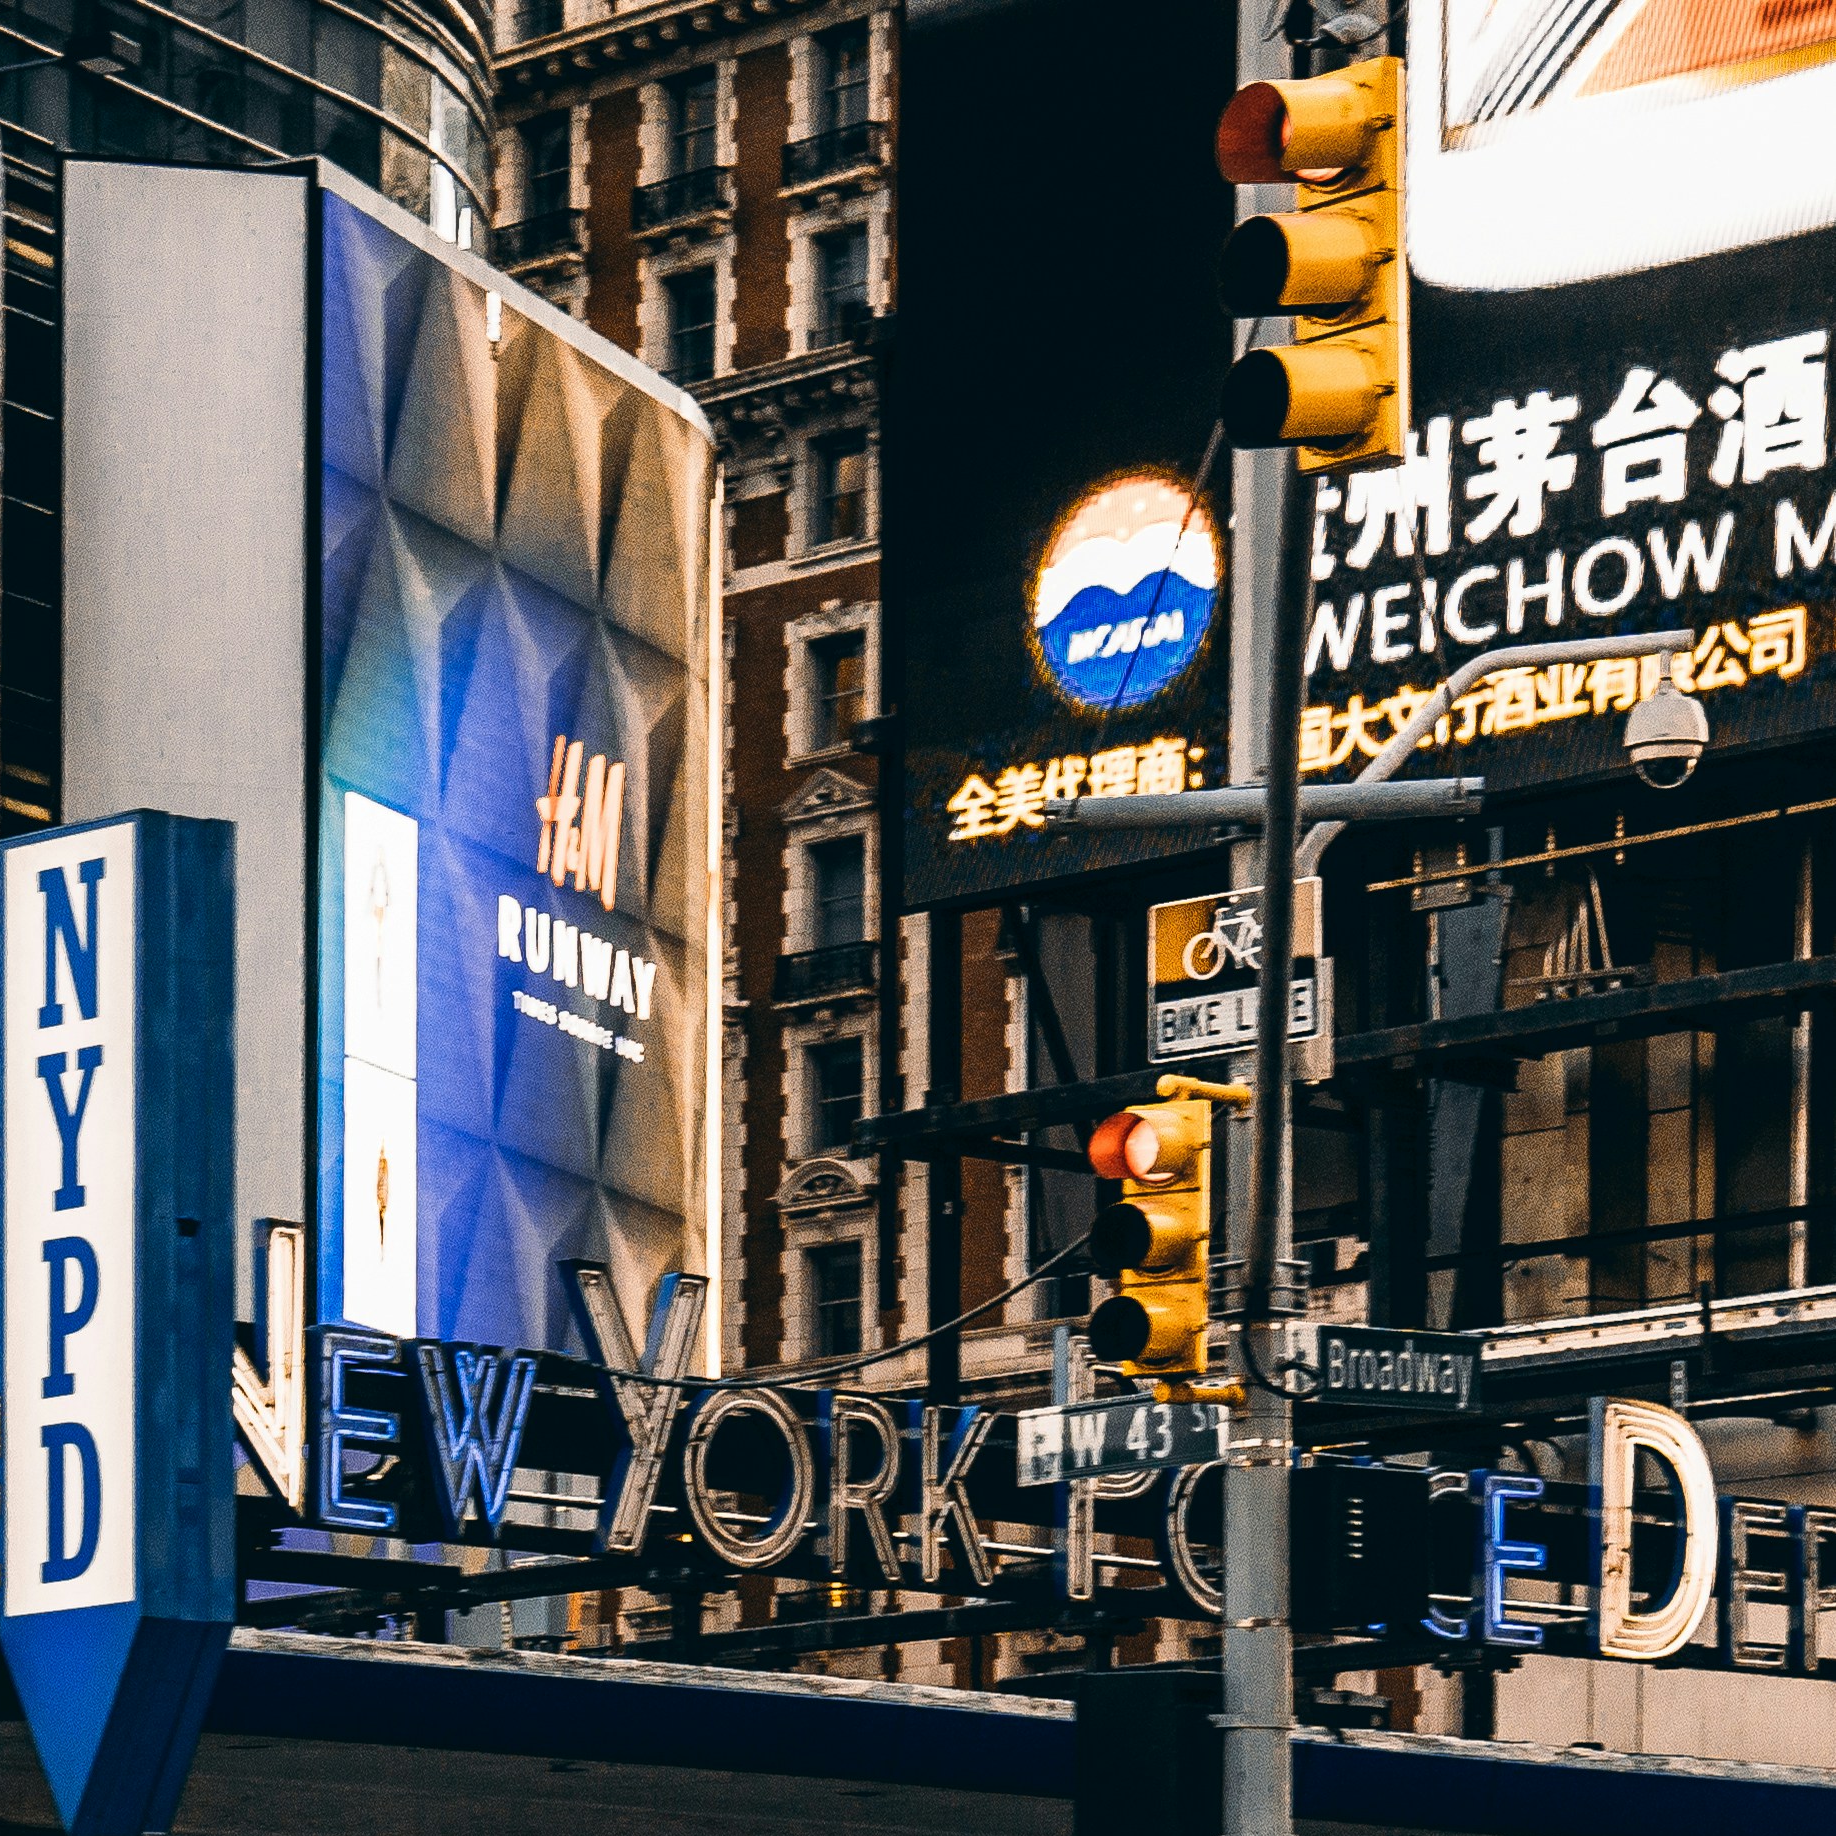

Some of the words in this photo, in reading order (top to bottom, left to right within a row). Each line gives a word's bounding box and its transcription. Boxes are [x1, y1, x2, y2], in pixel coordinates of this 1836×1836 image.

[536, 736, 626, 911] H&M
[498, 895, 657, 1020] RUNWAY
[1162, 1000, 1222, 1044] BIKE
[1235, 986, 1309, 1031] LE
[37, 857, 108, 1584] NYPD
[569, 1264, 1001, 1586] YORK
[1329, 1336, 1476, 1409] Broadway
[1069, 1411, 1108, 1468] W
[1126, 1403, 1174, 1460] 43
